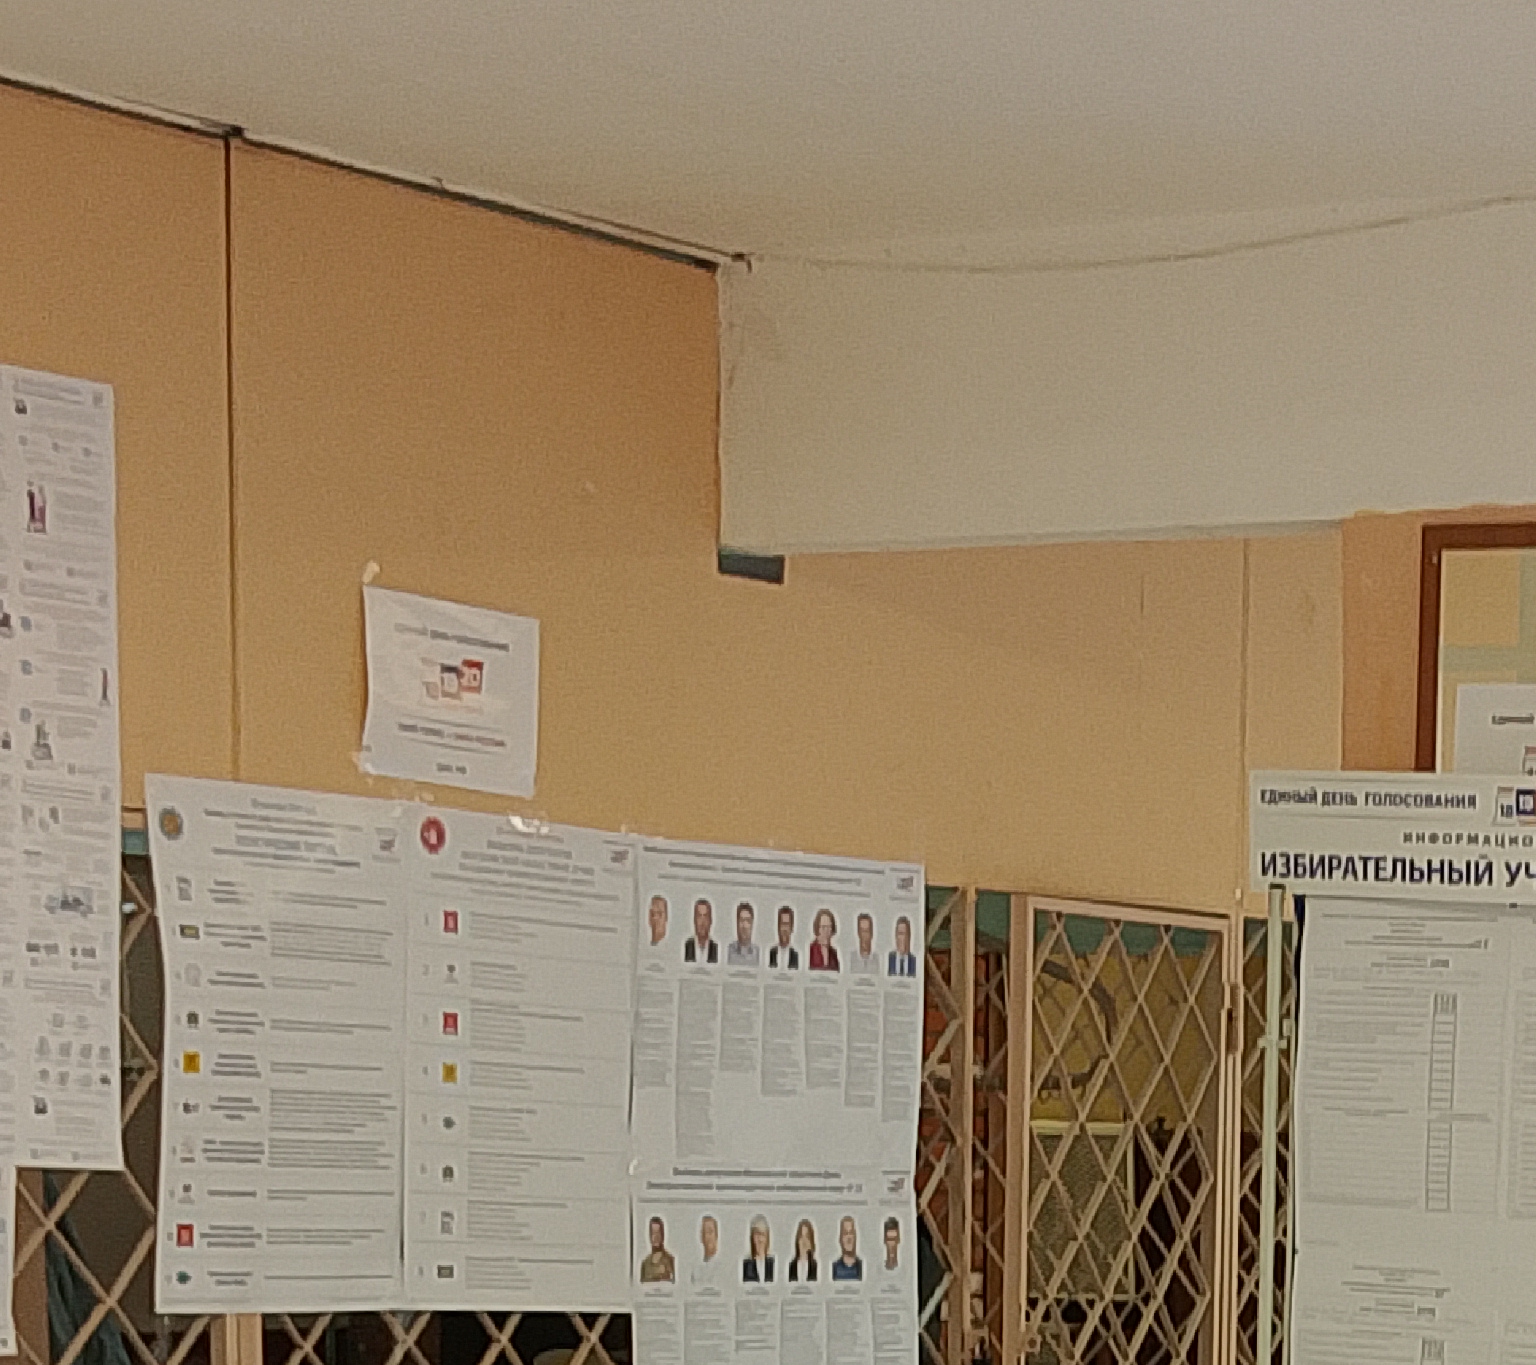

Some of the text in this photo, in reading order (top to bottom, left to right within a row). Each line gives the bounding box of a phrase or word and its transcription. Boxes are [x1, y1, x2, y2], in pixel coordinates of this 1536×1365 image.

[1260, 786, 1477, 810] ЕДИНЫЙ ДЕНЬ ГОЛОСОВАНИЯ
[1260, 851, 1494, 887] ИЗБИРАТЕЛЬНЫЙ
